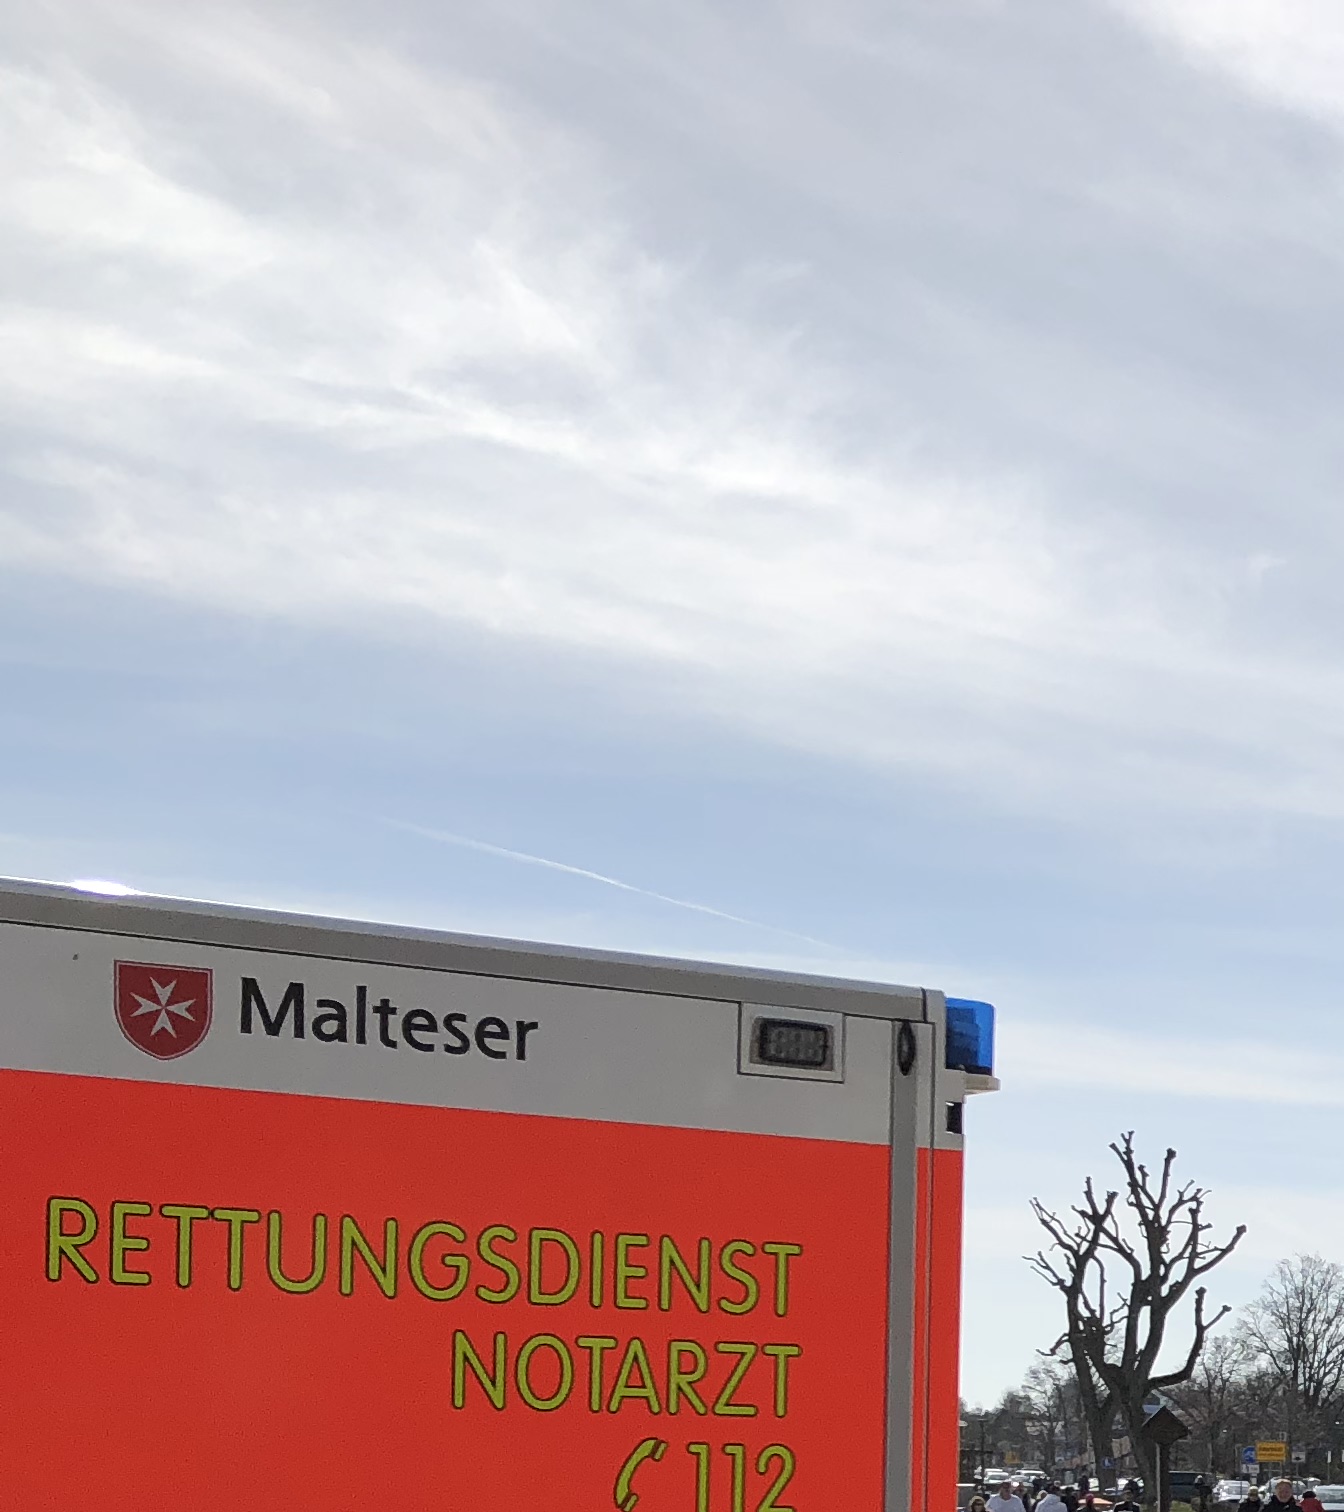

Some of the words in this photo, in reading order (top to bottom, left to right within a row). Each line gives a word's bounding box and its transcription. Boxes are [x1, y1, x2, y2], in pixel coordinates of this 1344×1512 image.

[240, 976, 539, 1061] Malteser
[45, 1197, 803, 1318] RETTUNGSDIENST
[451, 1330, 803, 1418] NOTARZT
